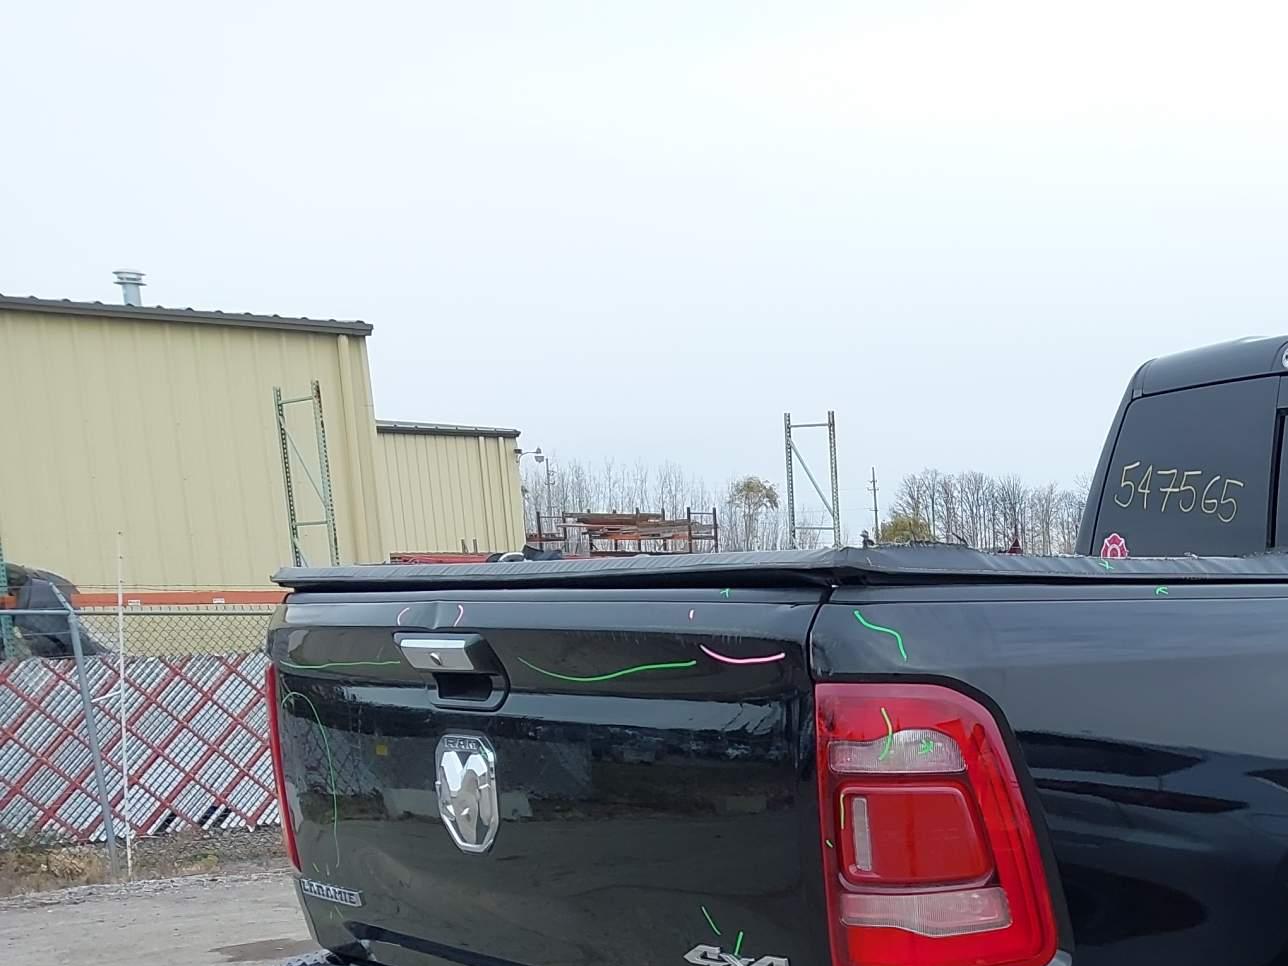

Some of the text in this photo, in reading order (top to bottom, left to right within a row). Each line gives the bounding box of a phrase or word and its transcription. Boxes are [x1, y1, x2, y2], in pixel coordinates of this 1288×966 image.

[1114, 461, 1244, 523] 547565
[443, 737, 480, 751] RAM
[301, 879, 360, 906] LARAMIE
